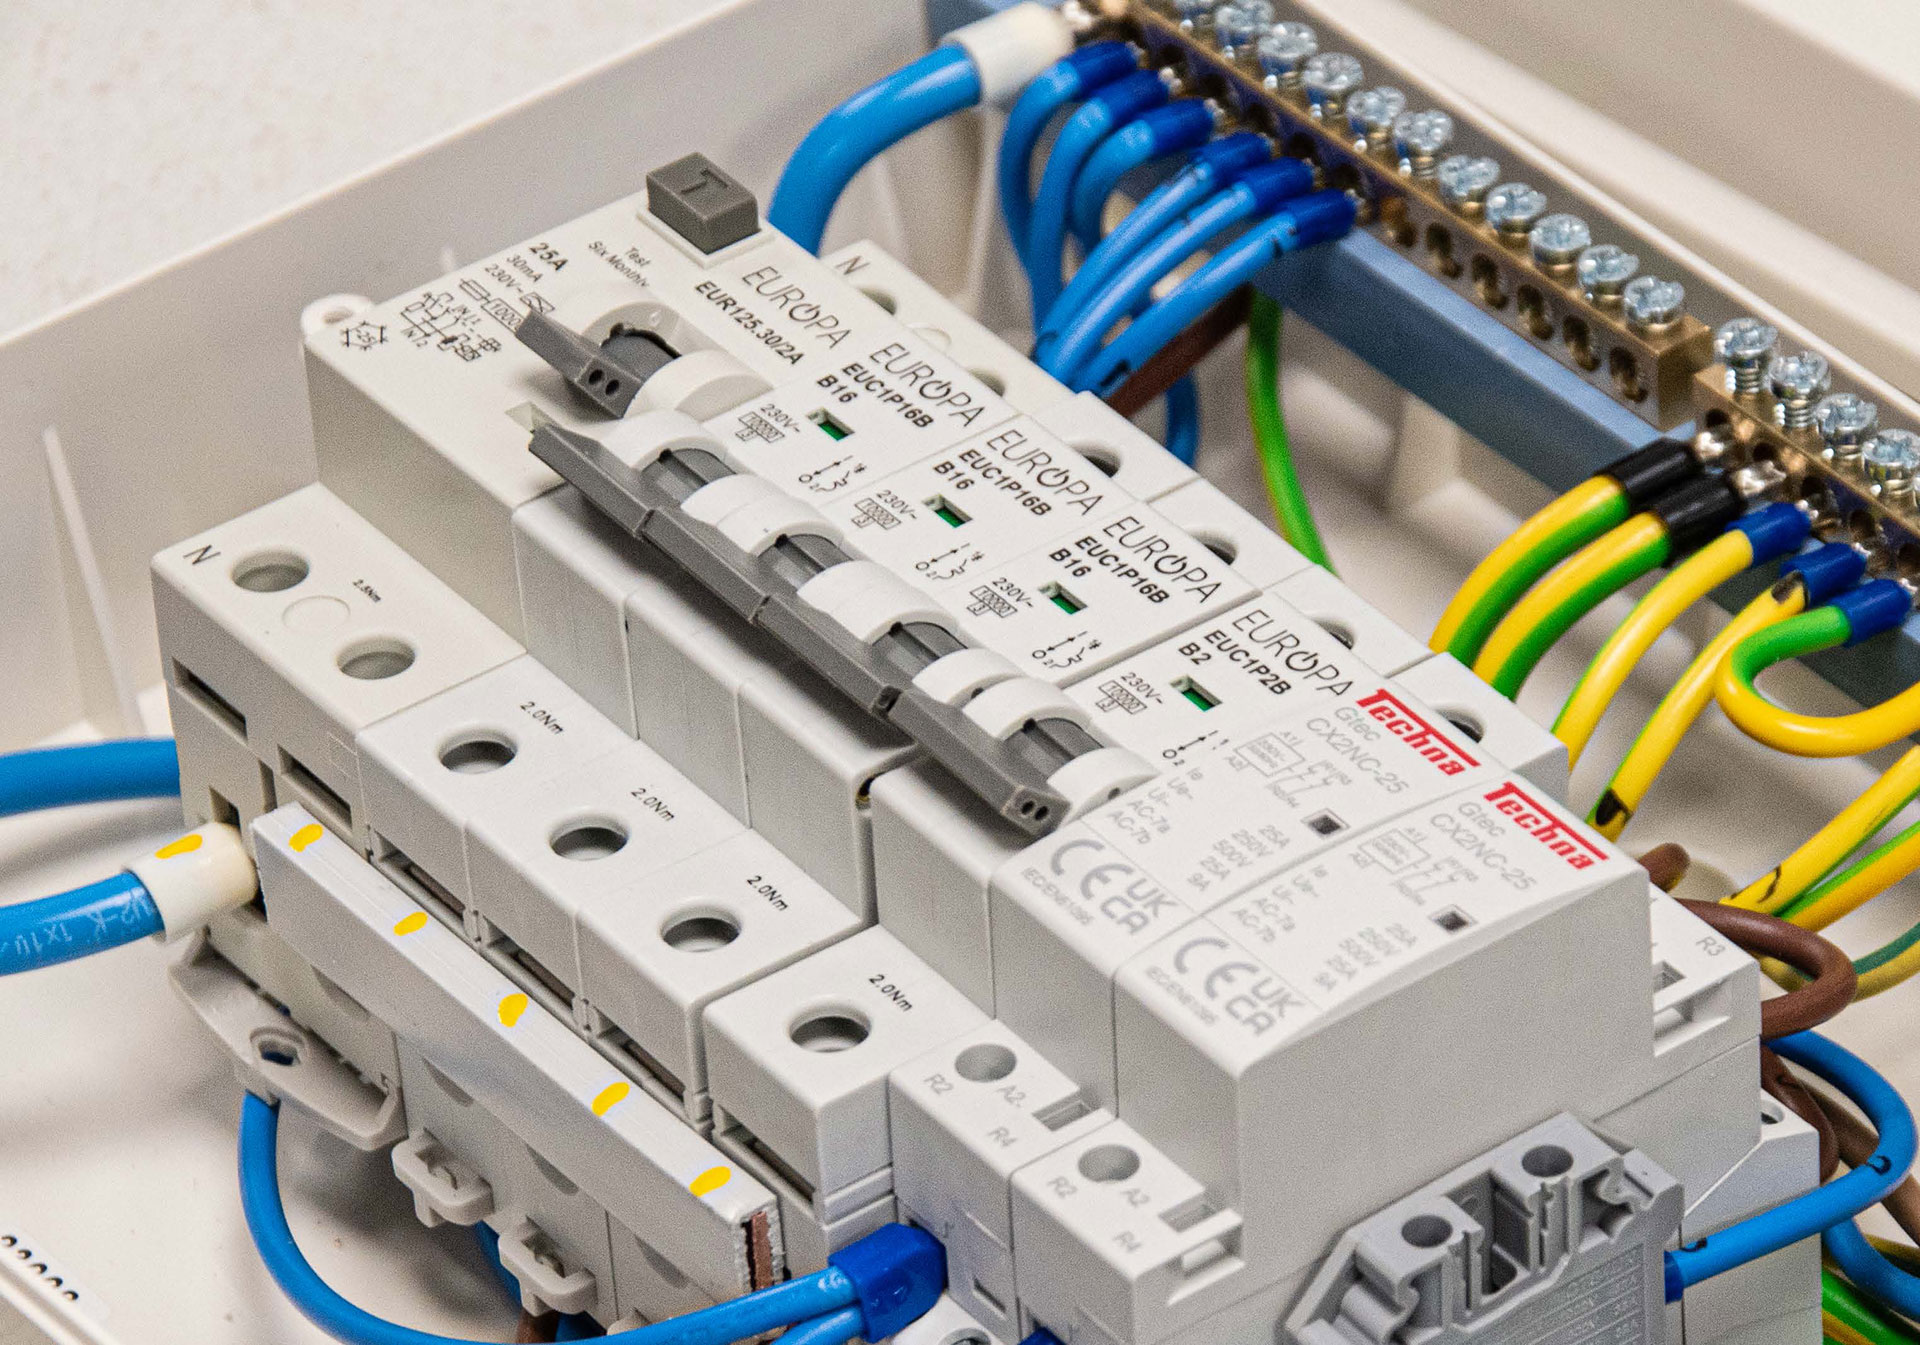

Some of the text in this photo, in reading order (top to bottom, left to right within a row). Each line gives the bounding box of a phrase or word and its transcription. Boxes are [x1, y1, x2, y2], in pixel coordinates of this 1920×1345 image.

[529, 242, 568, 272] 25A
[588, 241, 608, 256] Six
[625, 246, 651, 267] Test
[836, 255, 868, 276] N
[506, 254, 544, 283] 30mA
[694, 280, 805, 366] EUR125.30/2A
[742, 265, 851, 350] EUROPA
[816, 374, 858, 404] B16
[842, 362, 934, 429] EUC1P16B
[869, 342, 986, 428] EUROPA
[932, 460, 975, 491] B16
[959, 448, 1052, 517] EUC1P16B
[986, 429, 1104, 515] EUROPA
[183, 544, 221, 566] N
[1049, 548, 1092, 578] B16
[1074, 535, 1170, 604] EUC1P16B
[1102, 516, 1222, 604] EUROPA
[1178, 642, 1212, 666] B2
[1204, 629, 1291, 696] EUC1P2B
[1233, 609, 1354, 697] EUROPA
[520, 700, 565, 736] 2.0Nm
[1334, 706, 1381, 743] Gtec
[1356, 688, 1481, 776] Techna
[1306, 716, 1409, 795] CX2NC-25
[630, 787, 676, 823] 2.0Nm
[1457, 801, 1506, 838] Gtec
[1483, 781, 1611, 870] Techna
[1430, 813, 1537, 891] CX2NC-25
[746, 875, 789, 912] 2.0Nm
[1696, 936, 1726, 957] R3
[868, 974, 913, 1013] 2.0Nm
[924, 1073, 954, 1095] R2
[988, 1126, 1017, 1148] R4
[1048, 1176, 1078, 1198] R2
